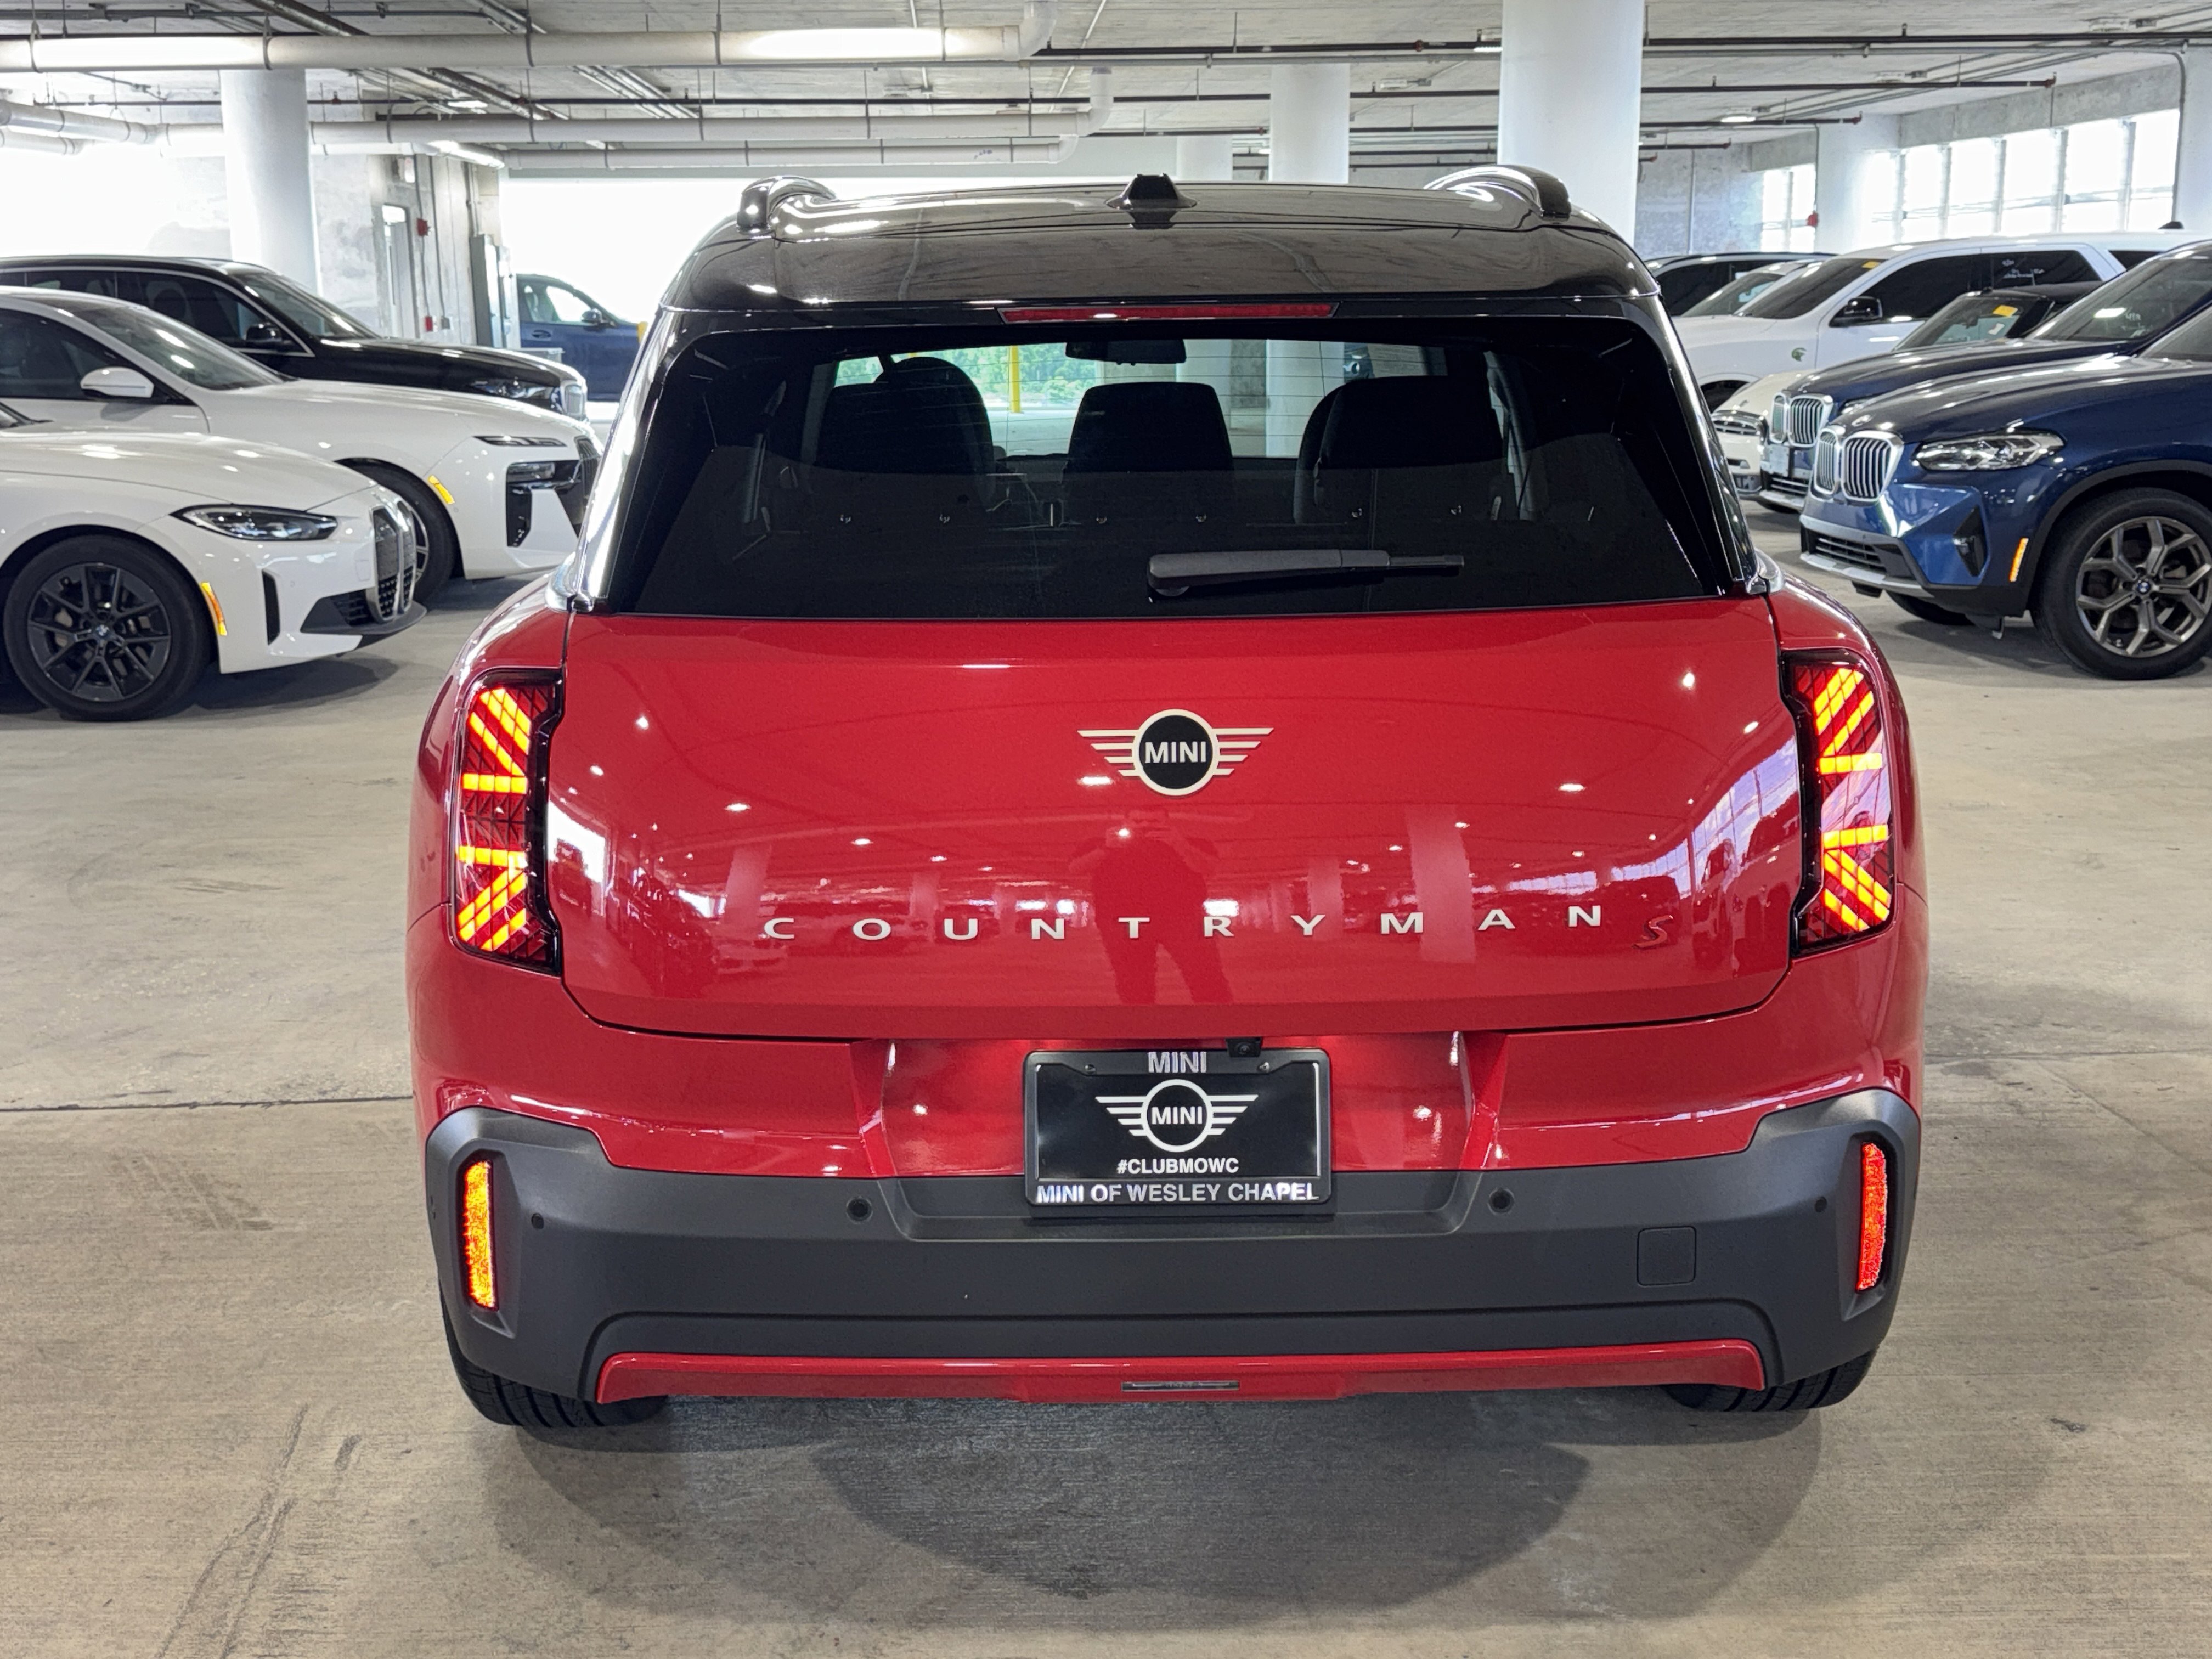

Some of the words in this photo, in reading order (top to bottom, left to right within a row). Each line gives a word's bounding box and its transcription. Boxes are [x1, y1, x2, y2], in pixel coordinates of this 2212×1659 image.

[1145, 741, 1206, 763] MINI
[764, 905, 1601, 940] COUNTRYMAN
[1631, 915, 1674, 949] S
[1148, 1051, 1207, 1073] MINI
[1152, 1106, 1203, 1125] MINI
[1116, 1158, 1239, 1174] #CLUBMOWC
[1036, 1184, 1084, 1203] MINI
[1090, 1184, 1122, 1202] OF
[1126, 1183, 1221, 1202] WESLEY
[1228, 1182, 1319, 1201] CHAPEL
